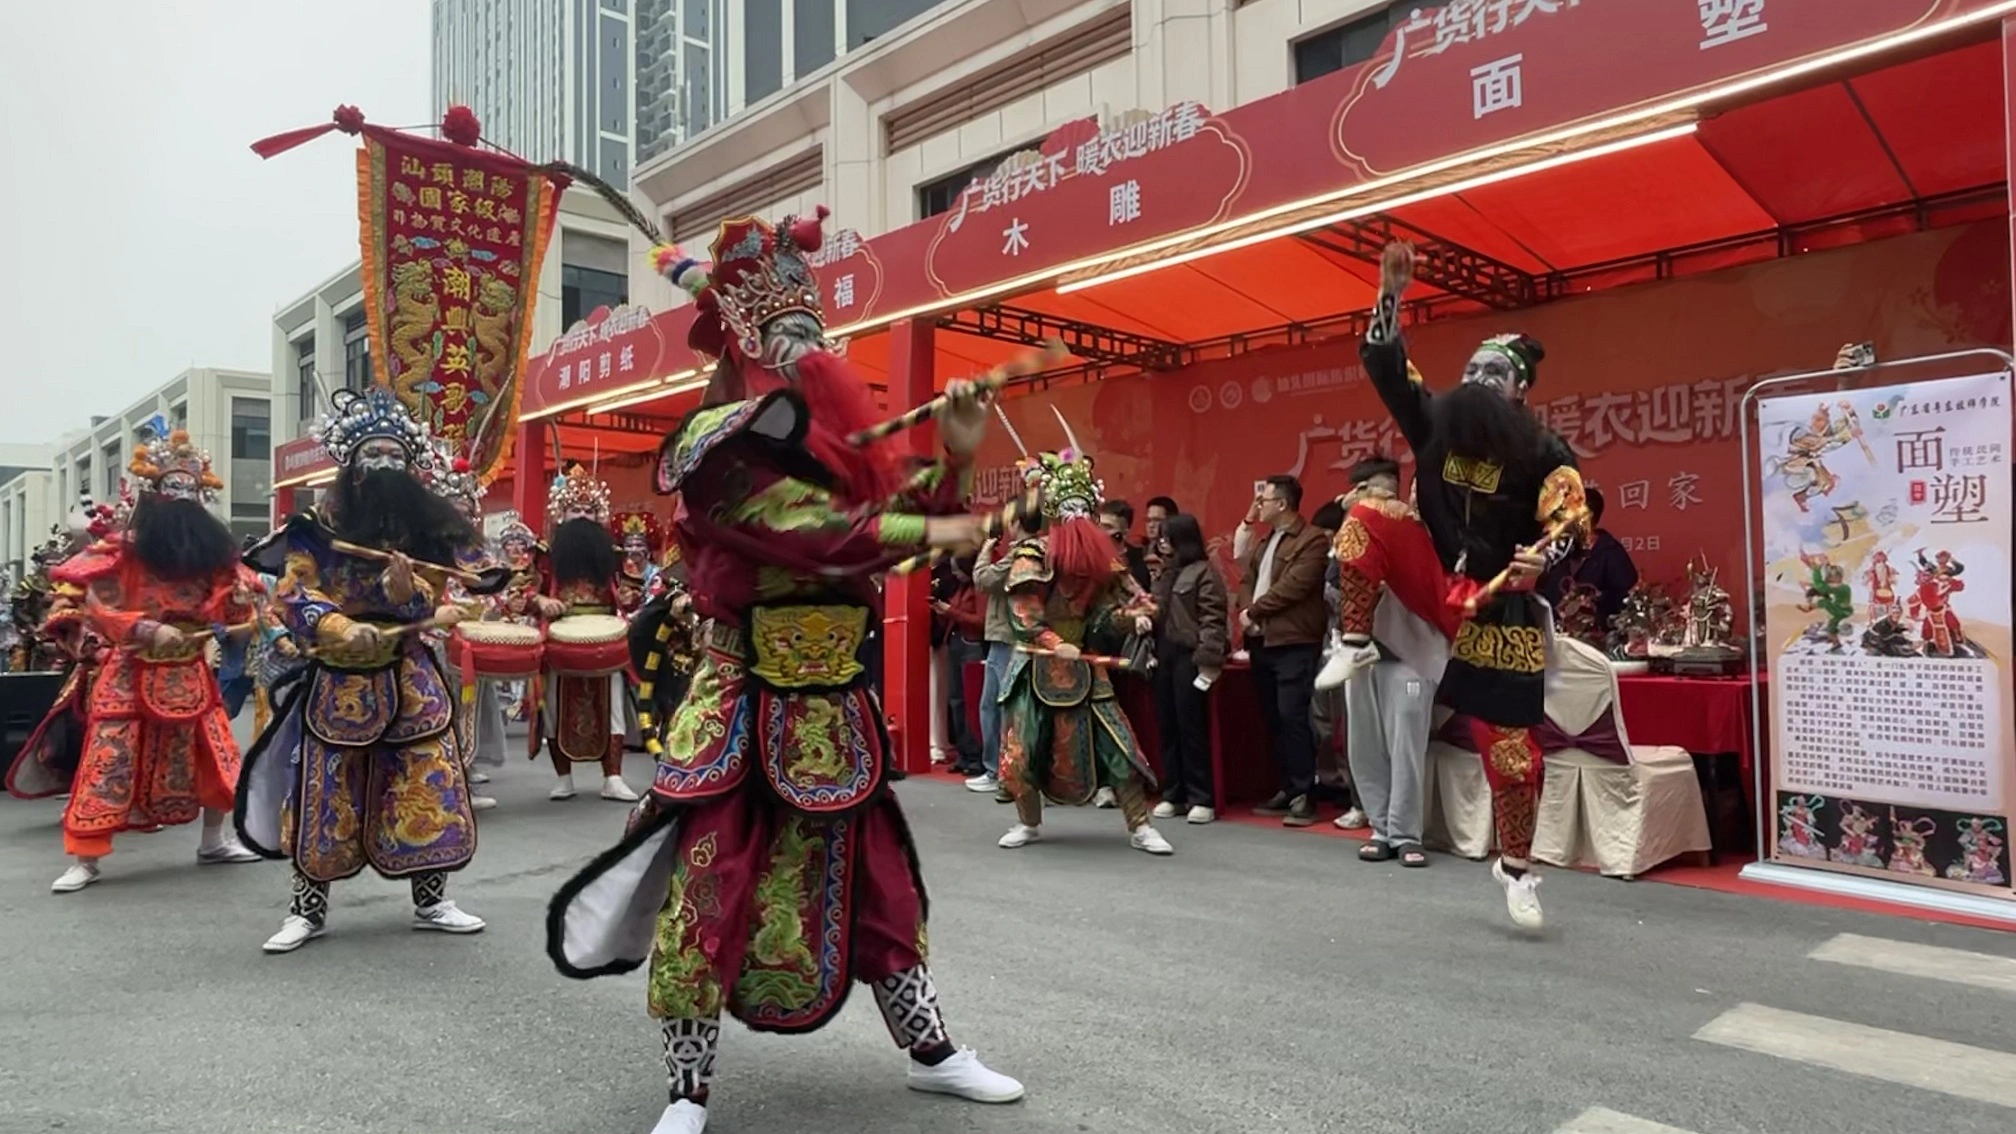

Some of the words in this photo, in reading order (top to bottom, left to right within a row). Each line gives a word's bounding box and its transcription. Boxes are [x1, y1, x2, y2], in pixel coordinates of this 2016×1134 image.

[1372, 0, 1580, 90] 广货行
[1470, 53, 1523, 119] 面
[1698, 0, 1768, 50] 塑
[949, 147, 1068, 233] 广货行天下
[1075, 100, 1206, 176] 暖衣迎新春
[1893, 425, 1946, 474] 面
[1930, 473, 1989, 524] 塑
